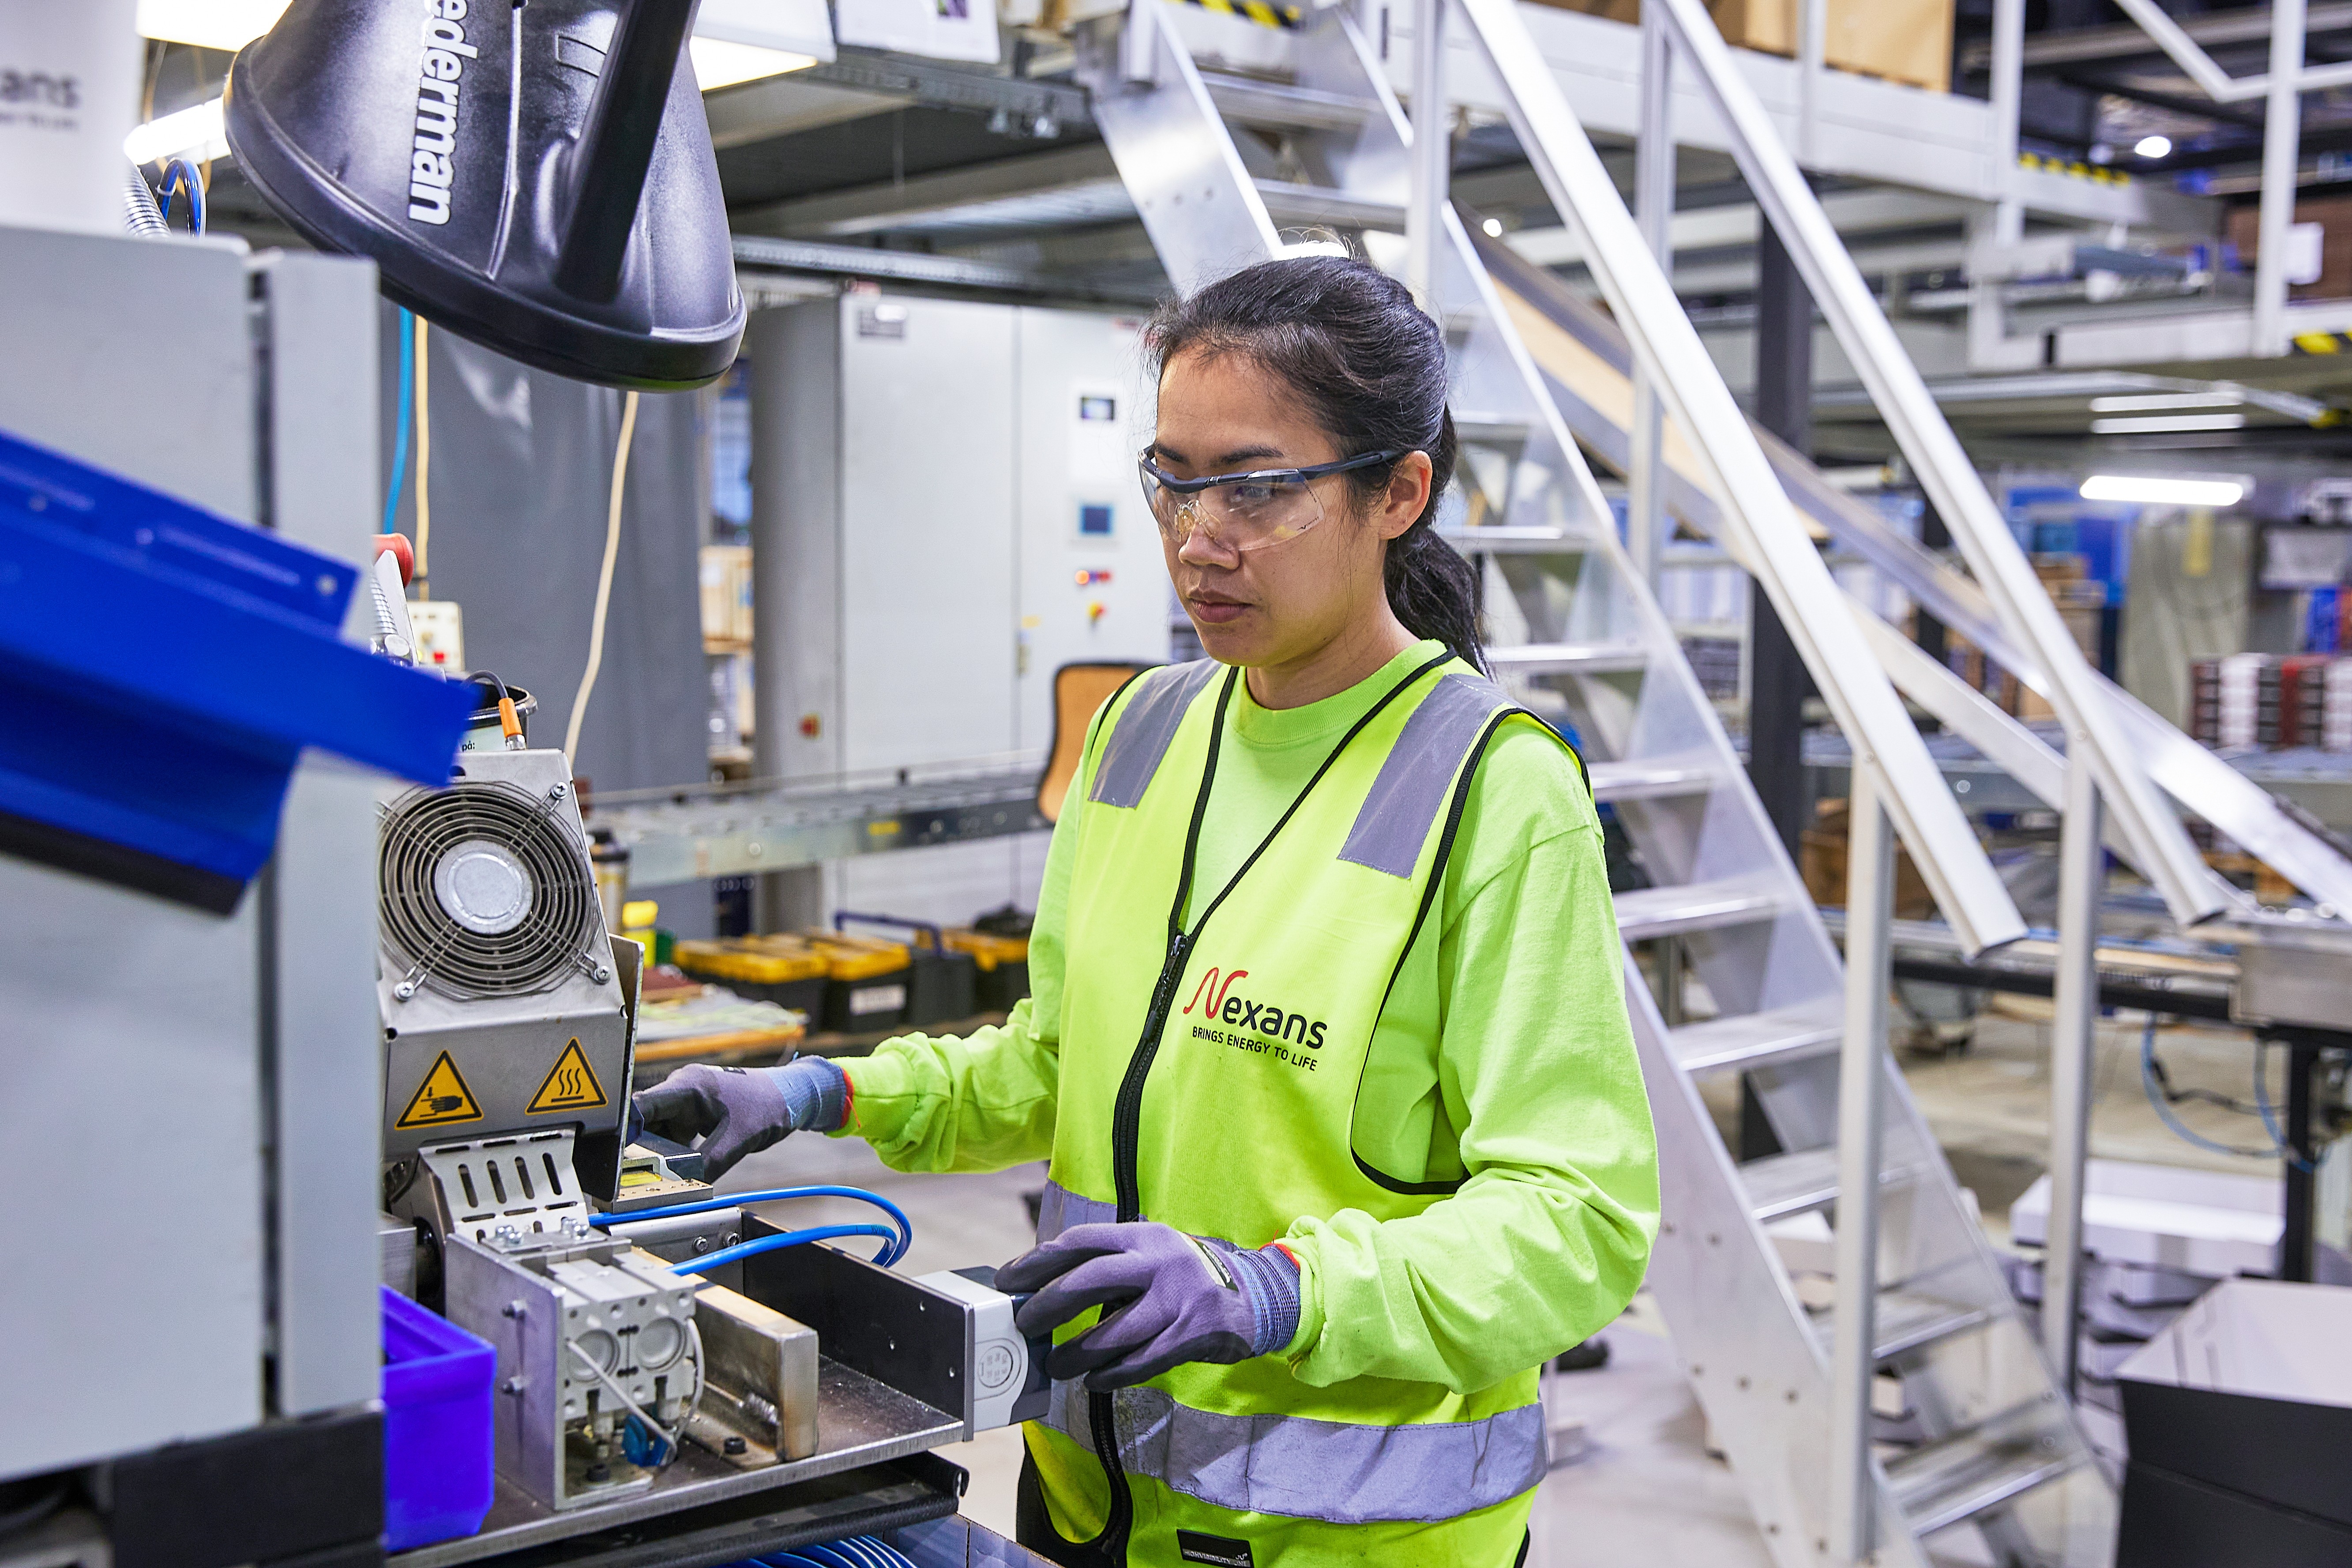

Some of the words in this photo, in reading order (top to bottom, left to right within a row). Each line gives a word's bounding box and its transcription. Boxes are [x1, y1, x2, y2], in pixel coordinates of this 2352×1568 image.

[1183, 967, 1327, 1049] Nexans
[1192, 1027, 1224, 1043] BRINGS
[1227, 1034, 1270, 1053] ENERGY
[1274, 1046, 1288, 1060] TO
[1291, 1053, 1318, 1071] LIFE
